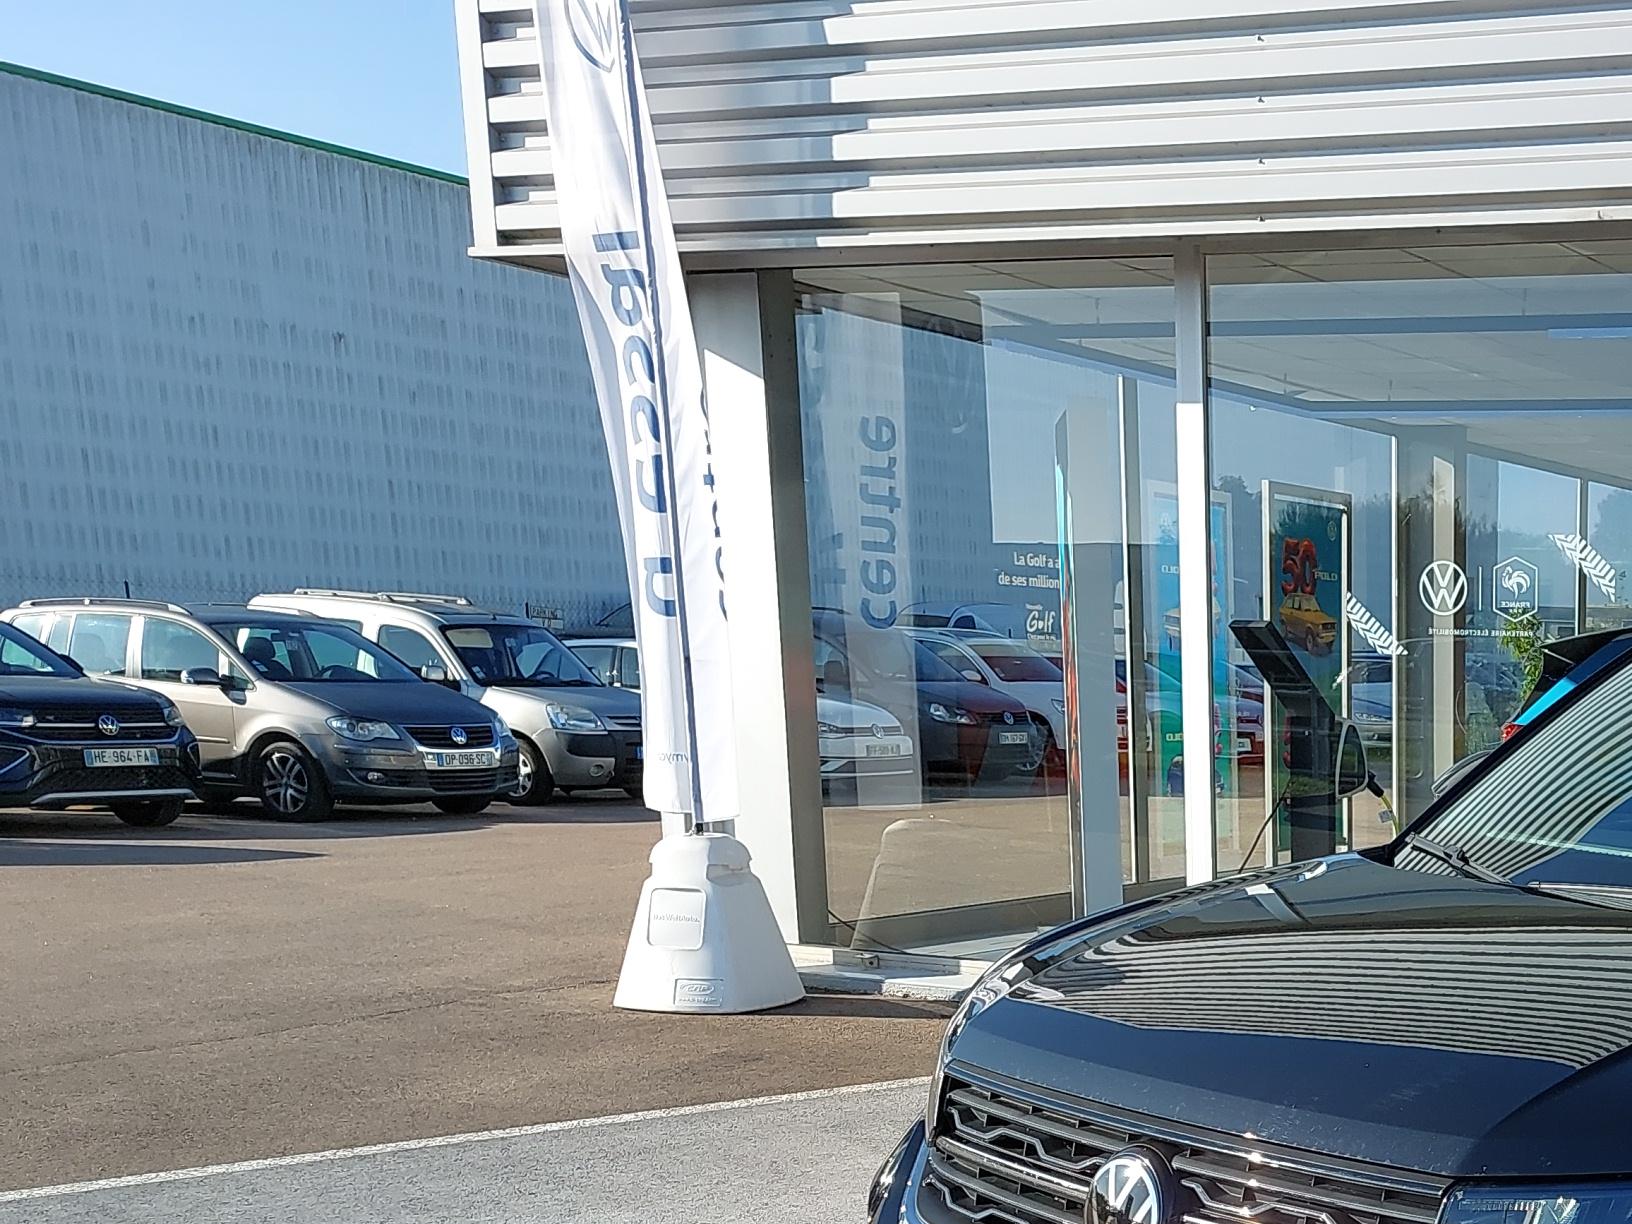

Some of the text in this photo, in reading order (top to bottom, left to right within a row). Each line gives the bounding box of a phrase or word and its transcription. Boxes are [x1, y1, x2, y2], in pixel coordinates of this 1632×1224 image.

[1013, 552, 1025, 566] La
[1027, 553, 1046, 568] Golf
[1281, 537, 1316, 596] 50
[998, 572, 1010, 586] de
[1012, 575, 1027, 587] ses
[1314, 571, 1338, 581] POLO
[1026, 610, 1056, 633] Golf
